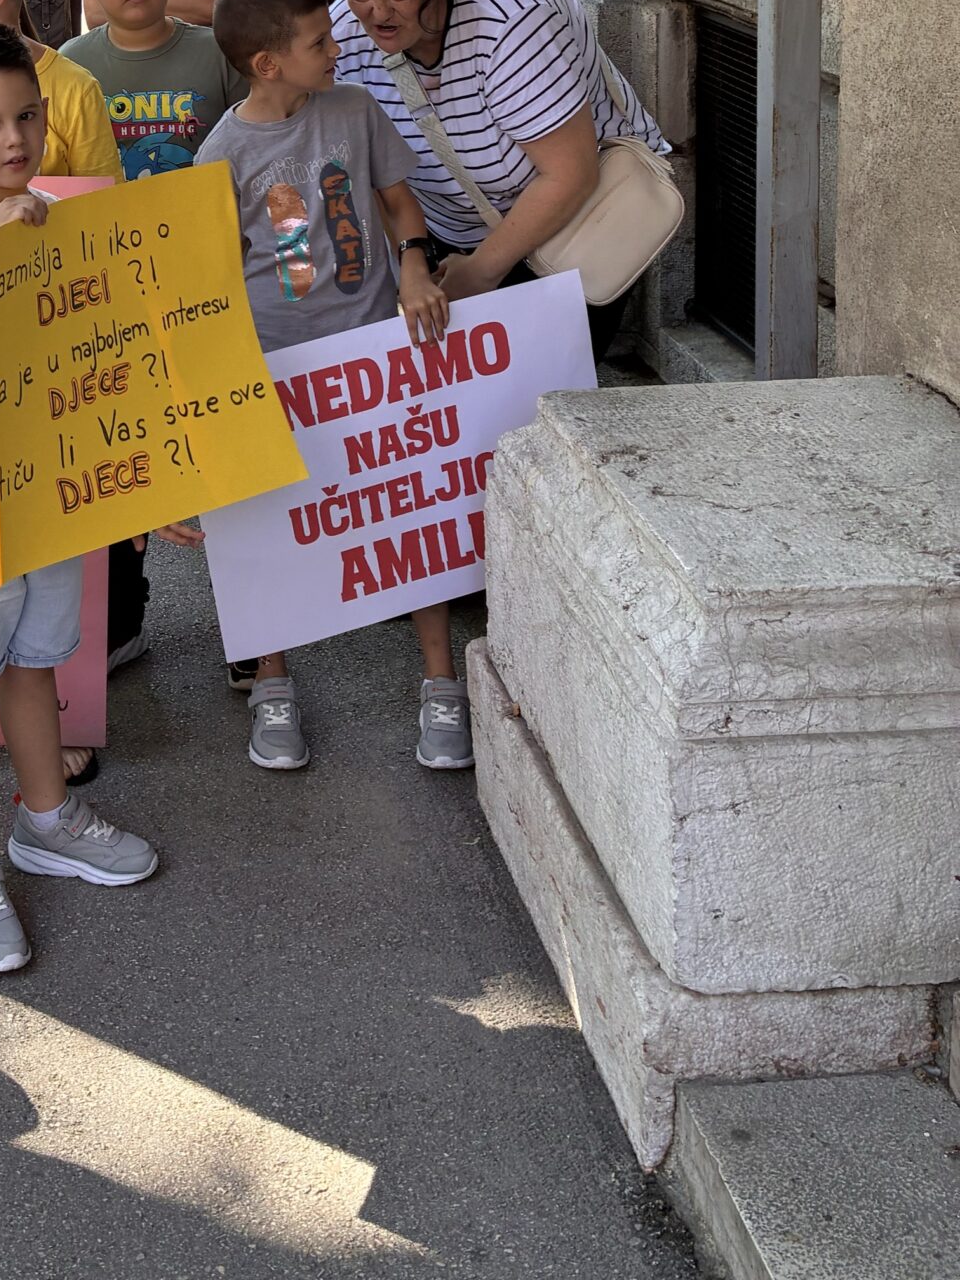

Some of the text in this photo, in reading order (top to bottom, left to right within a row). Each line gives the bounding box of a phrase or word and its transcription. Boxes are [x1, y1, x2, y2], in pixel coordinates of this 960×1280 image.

[108, 91, 193, 123] ONIC
[81, 230, 96, 262] li
[109, 221, 142, 257] iko
[157, 222, 170, 239] o
[36, 268, 112, 327] DJECI
[14, 361, 33, 408] je
[47, 351, 60, 373] u
[71, 319, 150, 373] najboljem
[161, 295, 230, 332] interesu
[272, 321, 512, 432] NEDAMO
[48, 361, 132, 421] DJECE
[58, 433, 75, 469] li
[98, 408, 148, 448] Vas
[164, 394, 220, 426] suze
[230, 381, 267, 407] ove
[343, 403, 461, 476] NAŠU
[56, 450, 152, 516] DJECE
[288, 449, 497, 546] UČITELJIC
